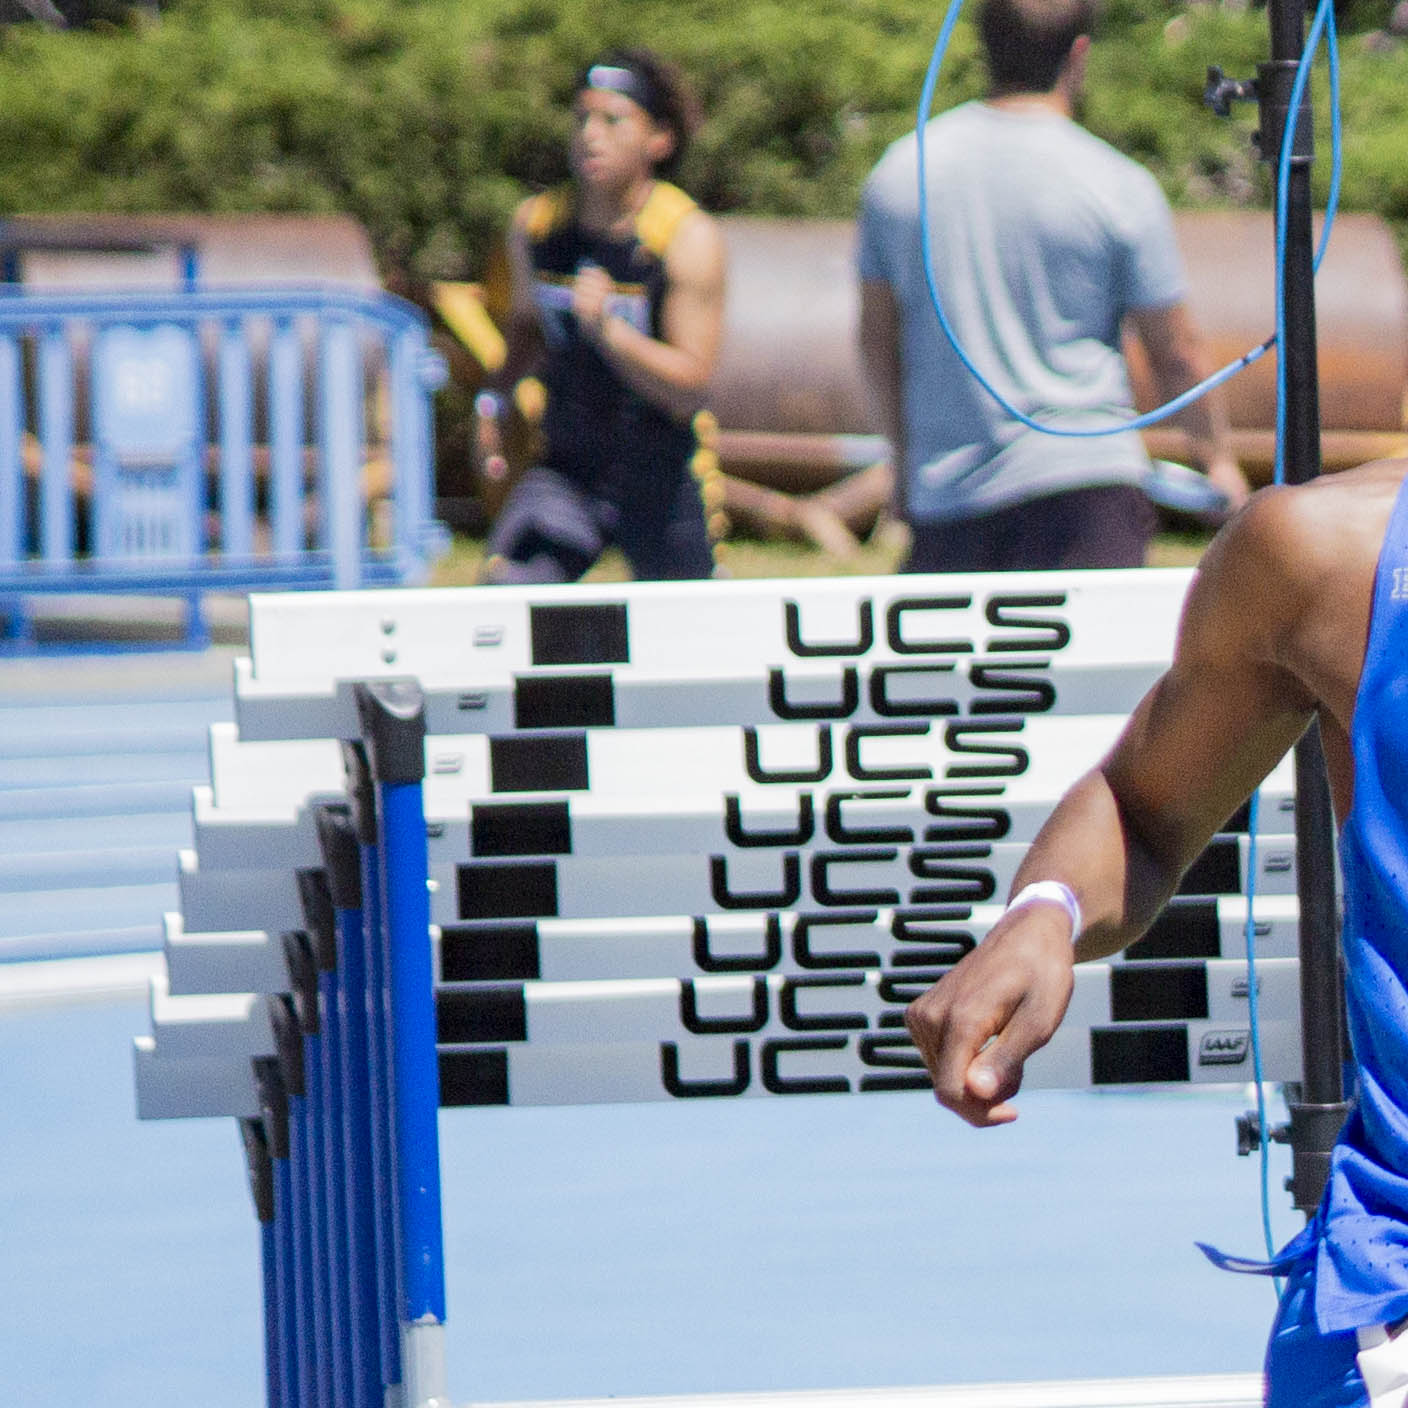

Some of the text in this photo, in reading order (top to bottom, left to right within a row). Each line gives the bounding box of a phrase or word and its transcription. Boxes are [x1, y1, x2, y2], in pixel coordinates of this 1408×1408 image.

[784, 592, 1071, 657] UCS
[768, 660, 1057, 720] UCS
[745, 717, 1030, 784] UCS
[724, 786, 1011, 848] UCS
[709, 844, 996, 909] UCS
[692, 906, 977, 973] UCS
